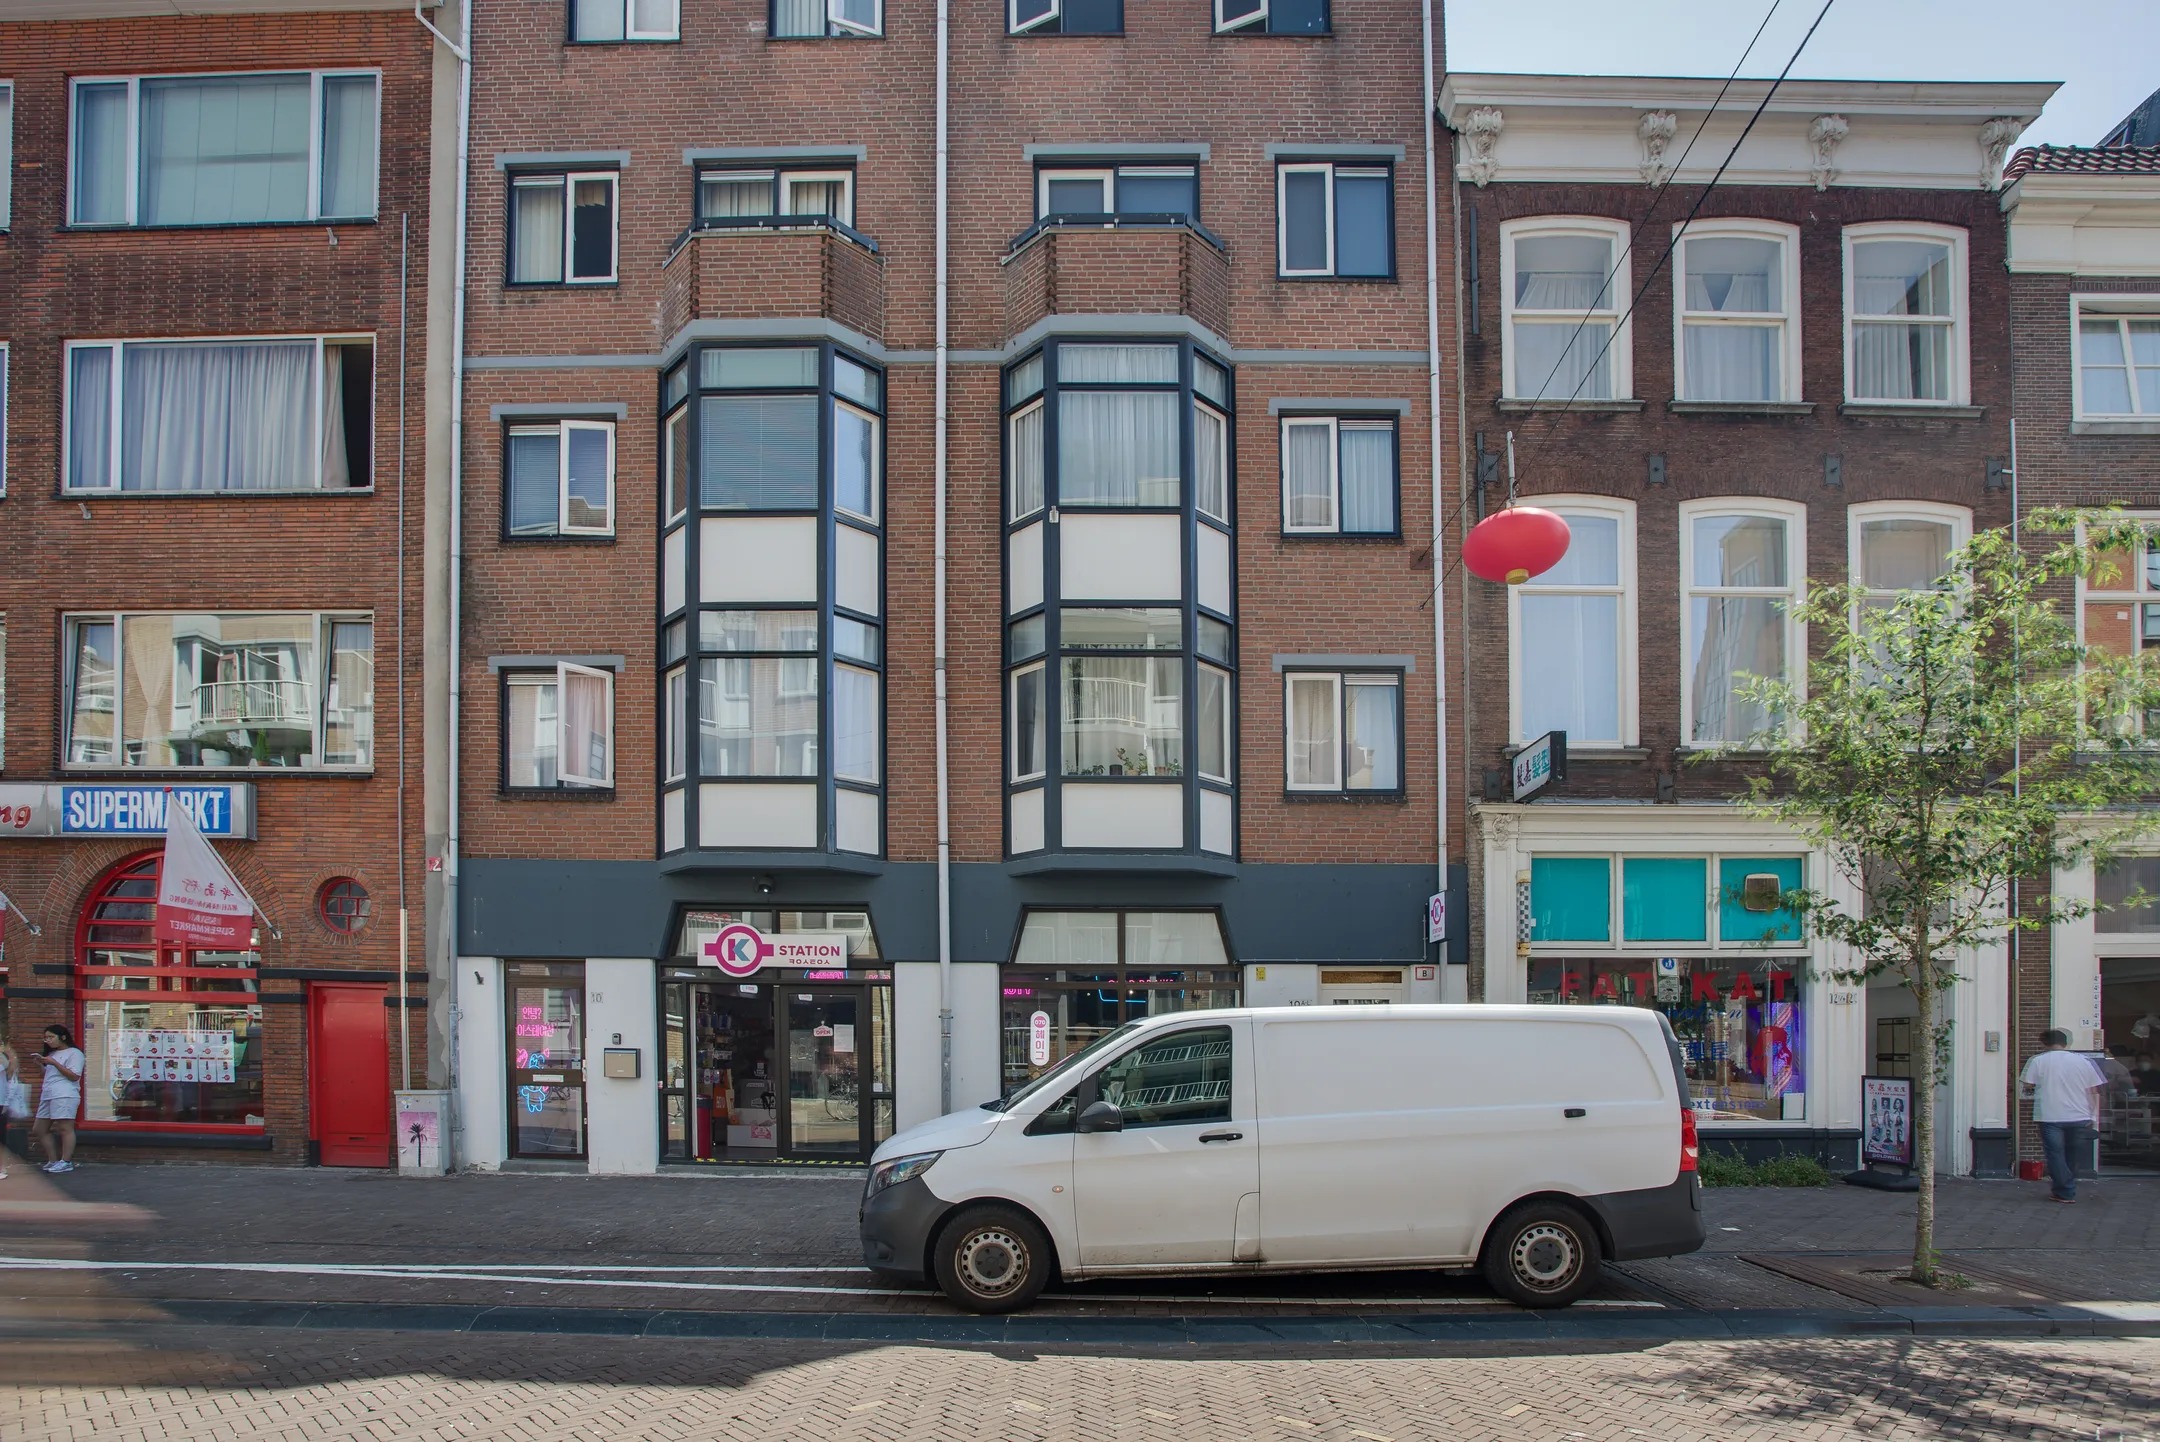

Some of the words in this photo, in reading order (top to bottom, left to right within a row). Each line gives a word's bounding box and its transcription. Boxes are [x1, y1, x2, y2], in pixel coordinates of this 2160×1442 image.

[727, 938, 751, 961] K
[779, 945, 840, 957] STATION
[1692, 971, 1792, 1000] KAT
[592, 993, 602, 1003] 10
[1690, 1098, 1768, 1111] extensions
